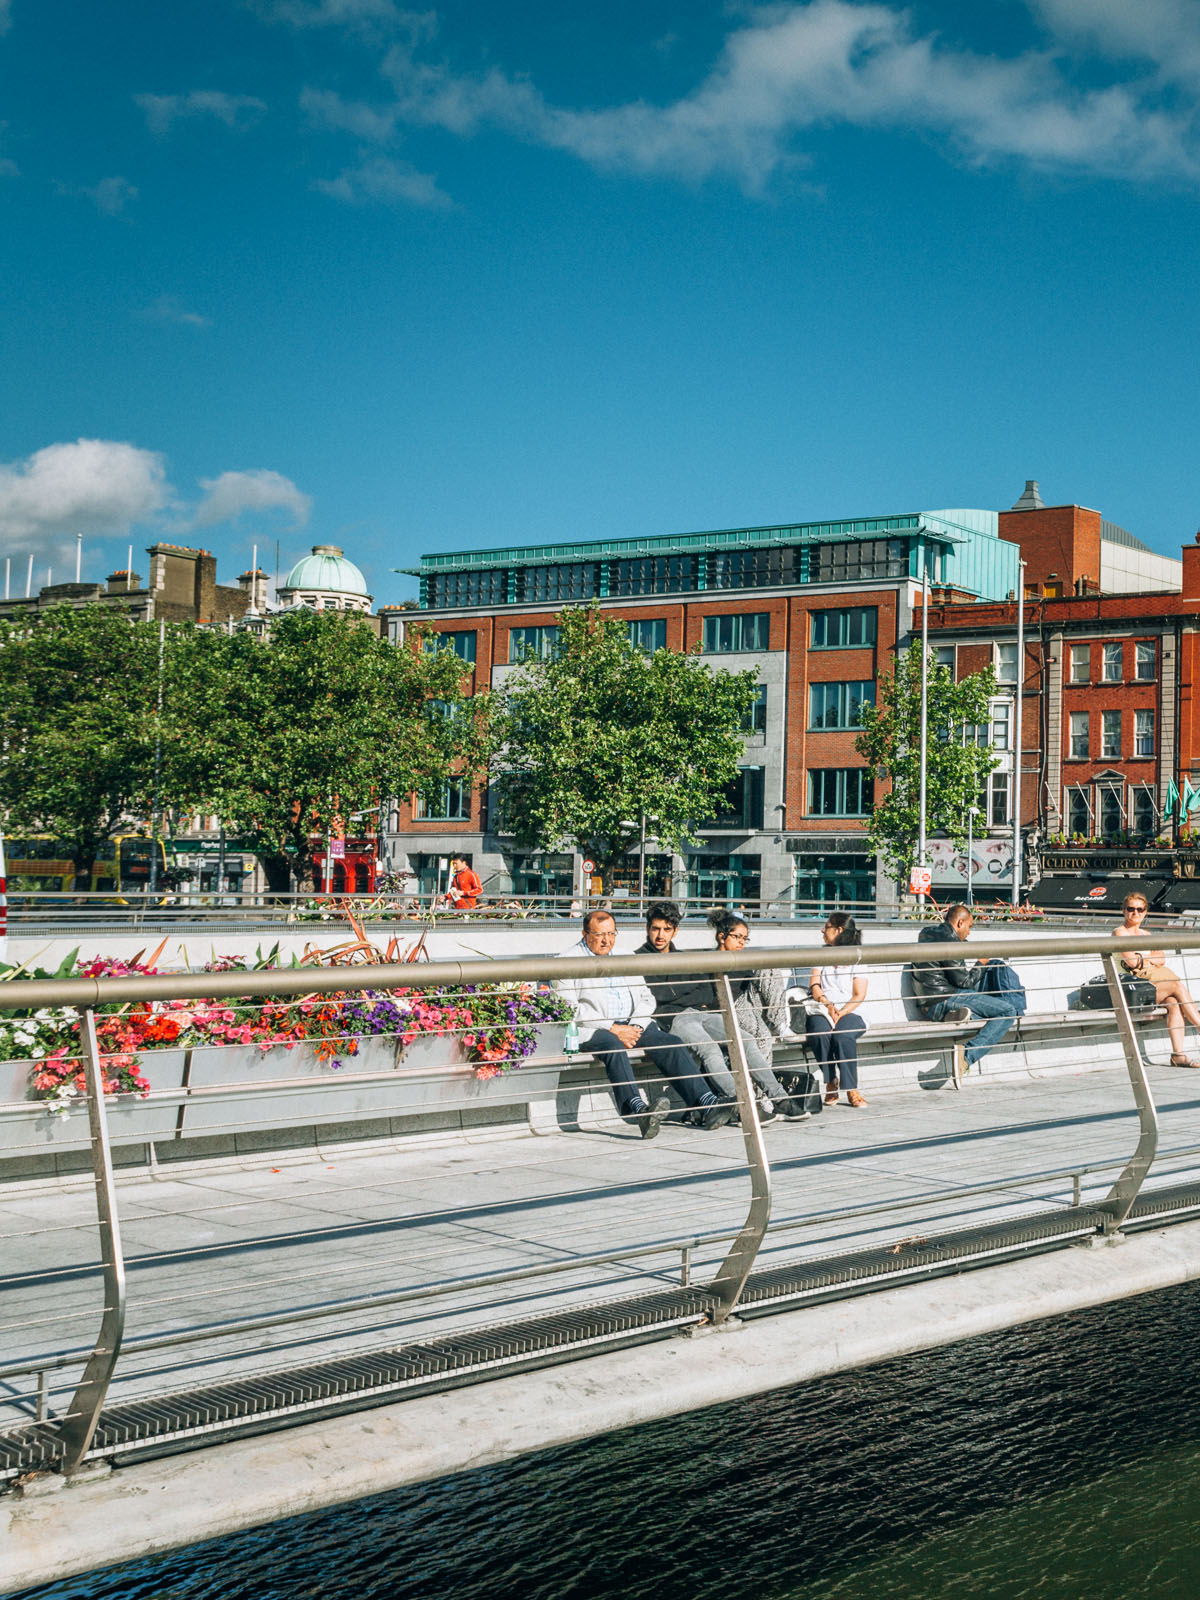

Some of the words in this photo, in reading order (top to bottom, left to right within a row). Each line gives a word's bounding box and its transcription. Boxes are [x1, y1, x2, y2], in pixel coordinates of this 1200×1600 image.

[1046, 857, 1091, 869] CLIFTON
[1093, 858, 1131, 869] COURT
[1133, 858, 1158, 869] BAR
